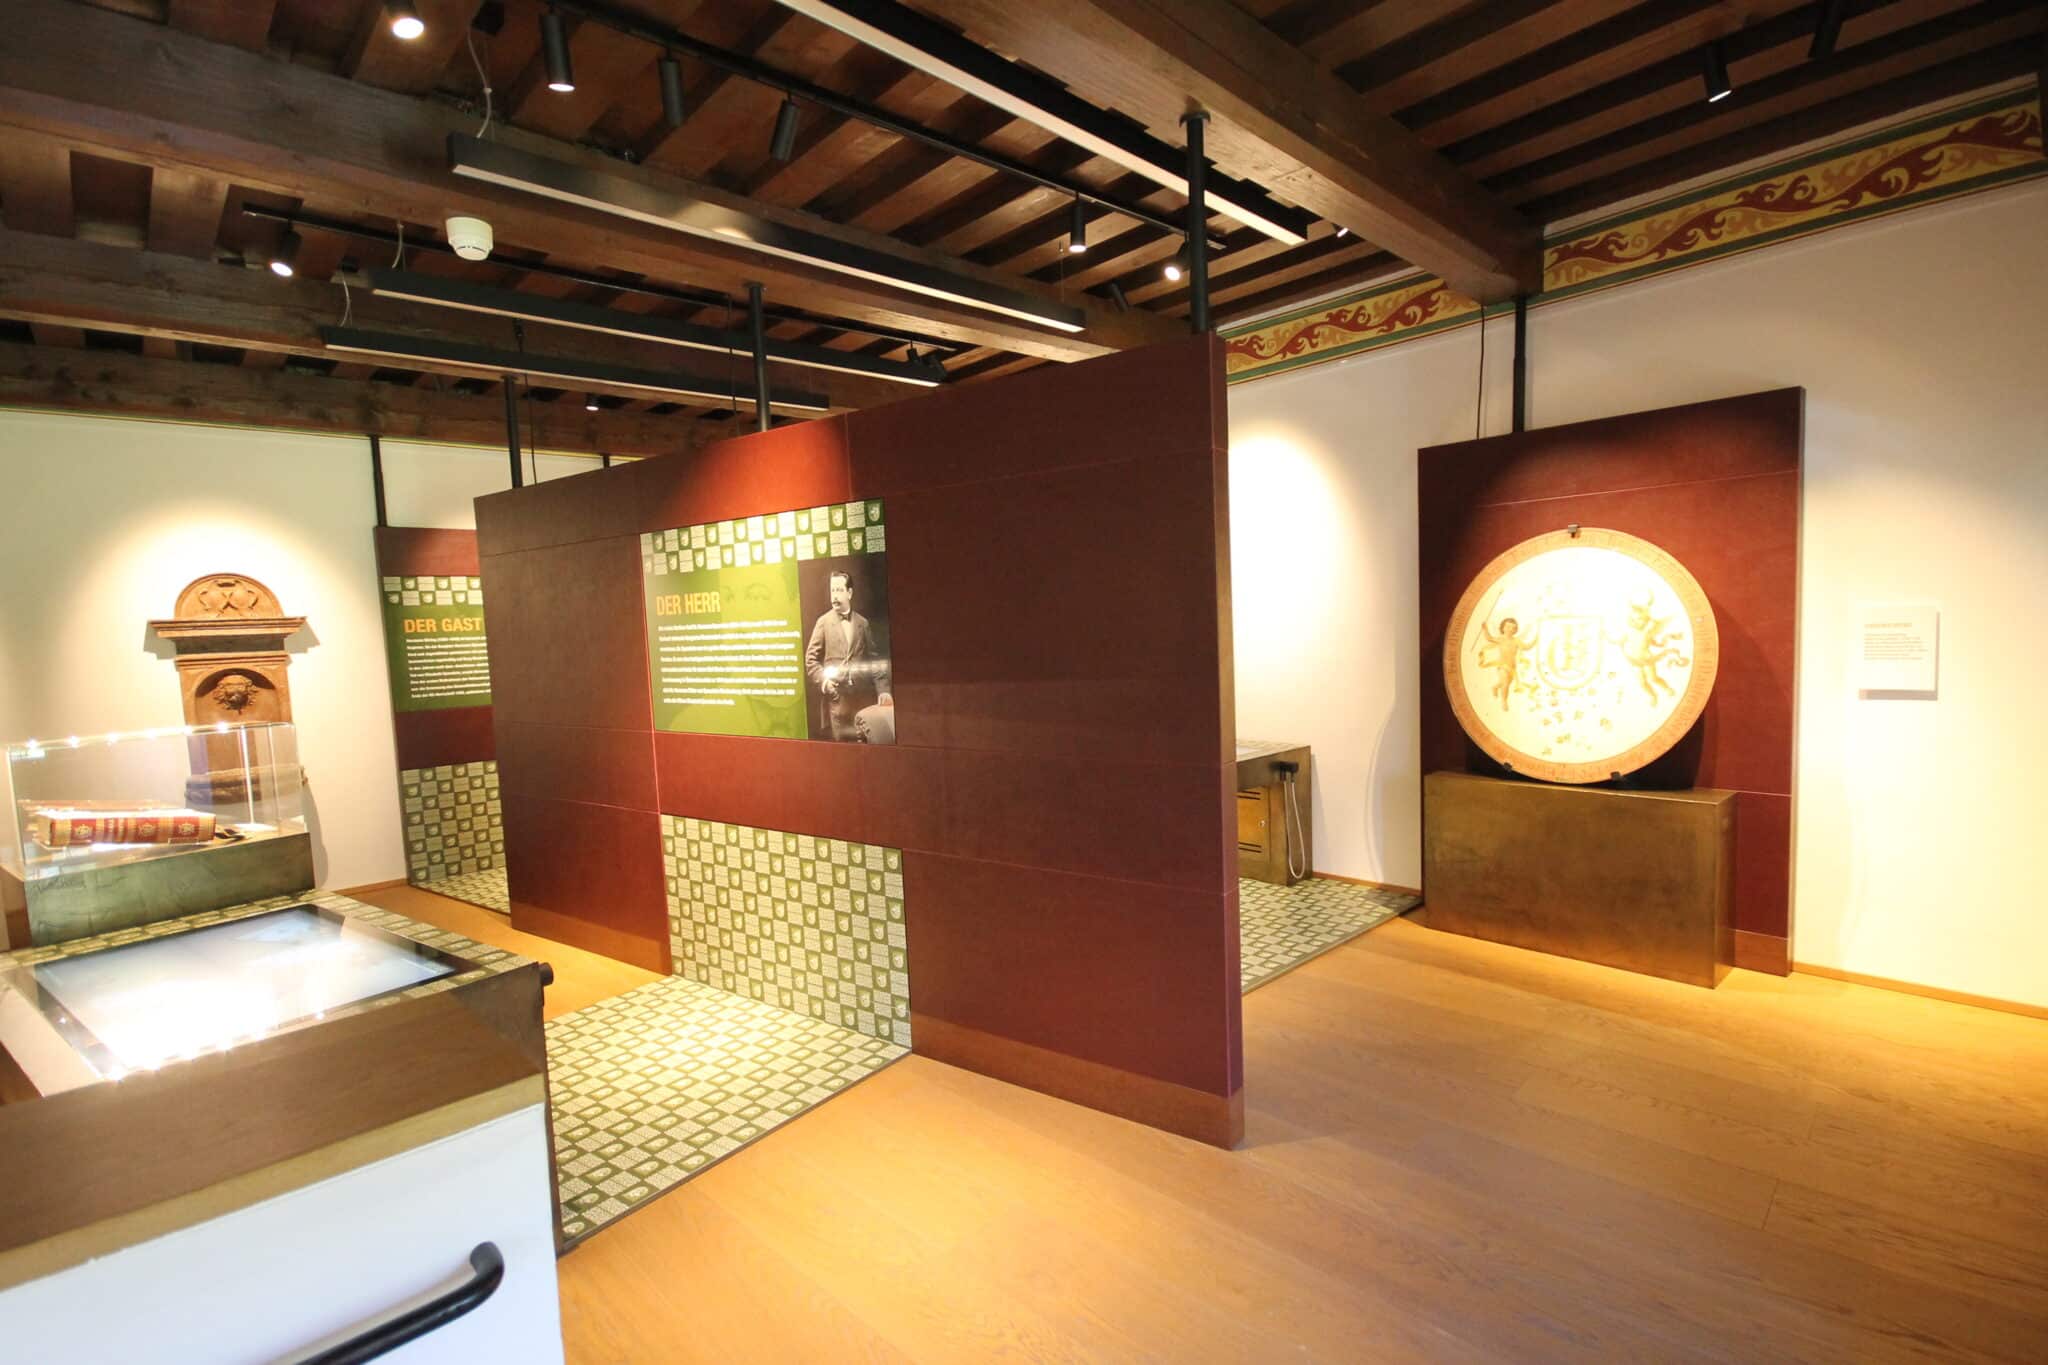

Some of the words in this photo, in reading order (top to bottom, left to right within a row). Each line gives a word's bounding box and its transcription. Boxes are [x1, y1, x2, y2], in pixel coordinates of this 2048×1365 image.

[656, 594, 681, 616] DER
[684, 591, 721, 614] HERR
[404, 618, 437, 633] DER
[442, 617, 482, 632] GAST
